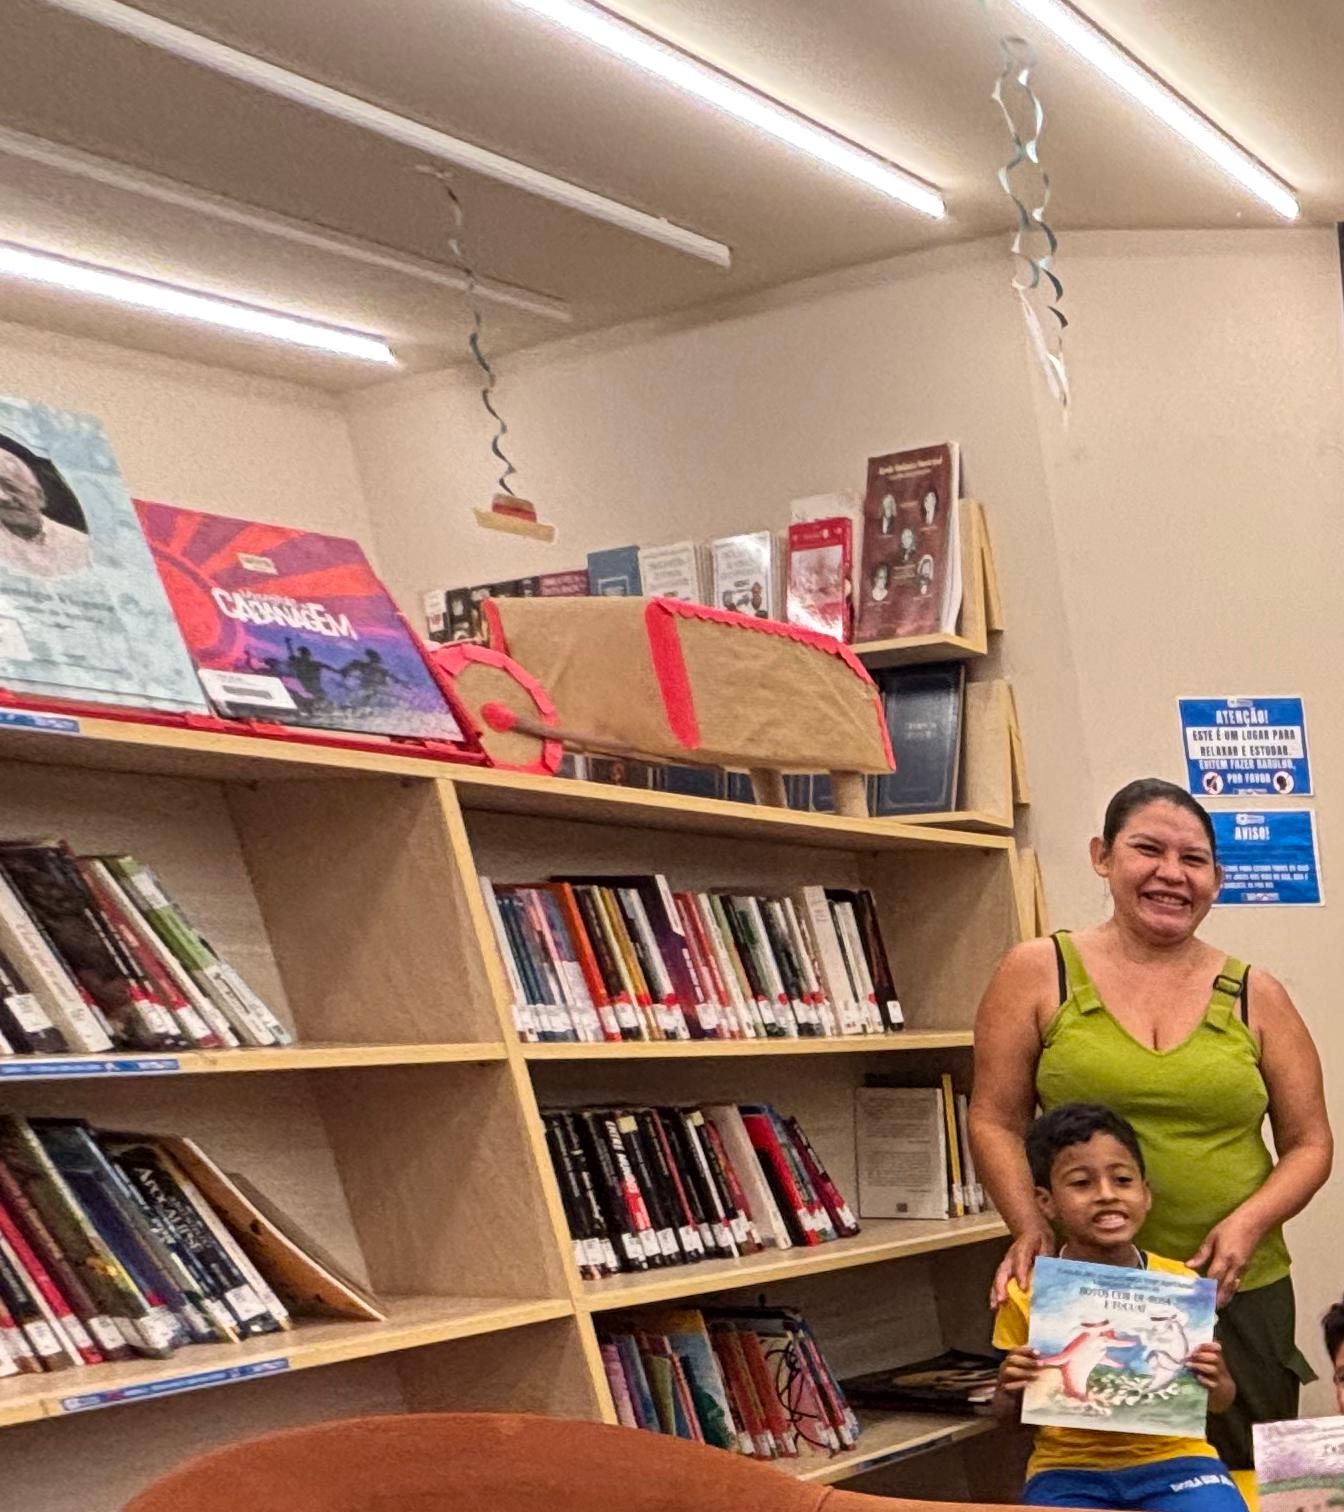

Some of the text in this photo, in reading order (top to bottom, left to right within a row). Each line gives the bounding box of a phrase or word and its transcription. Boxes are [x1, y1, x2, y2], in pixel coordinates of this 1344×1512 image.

[1216, 707, 1269, 726] ATENÇÃO!
[1192, 728, 1295, 741] ESTE É UM LUGAR PARA
[1200, 746, 1238, 757] RELAXAR
[1241, 746, 1246, 756] E
[1234, 826, 1270, 841] AVISO!
